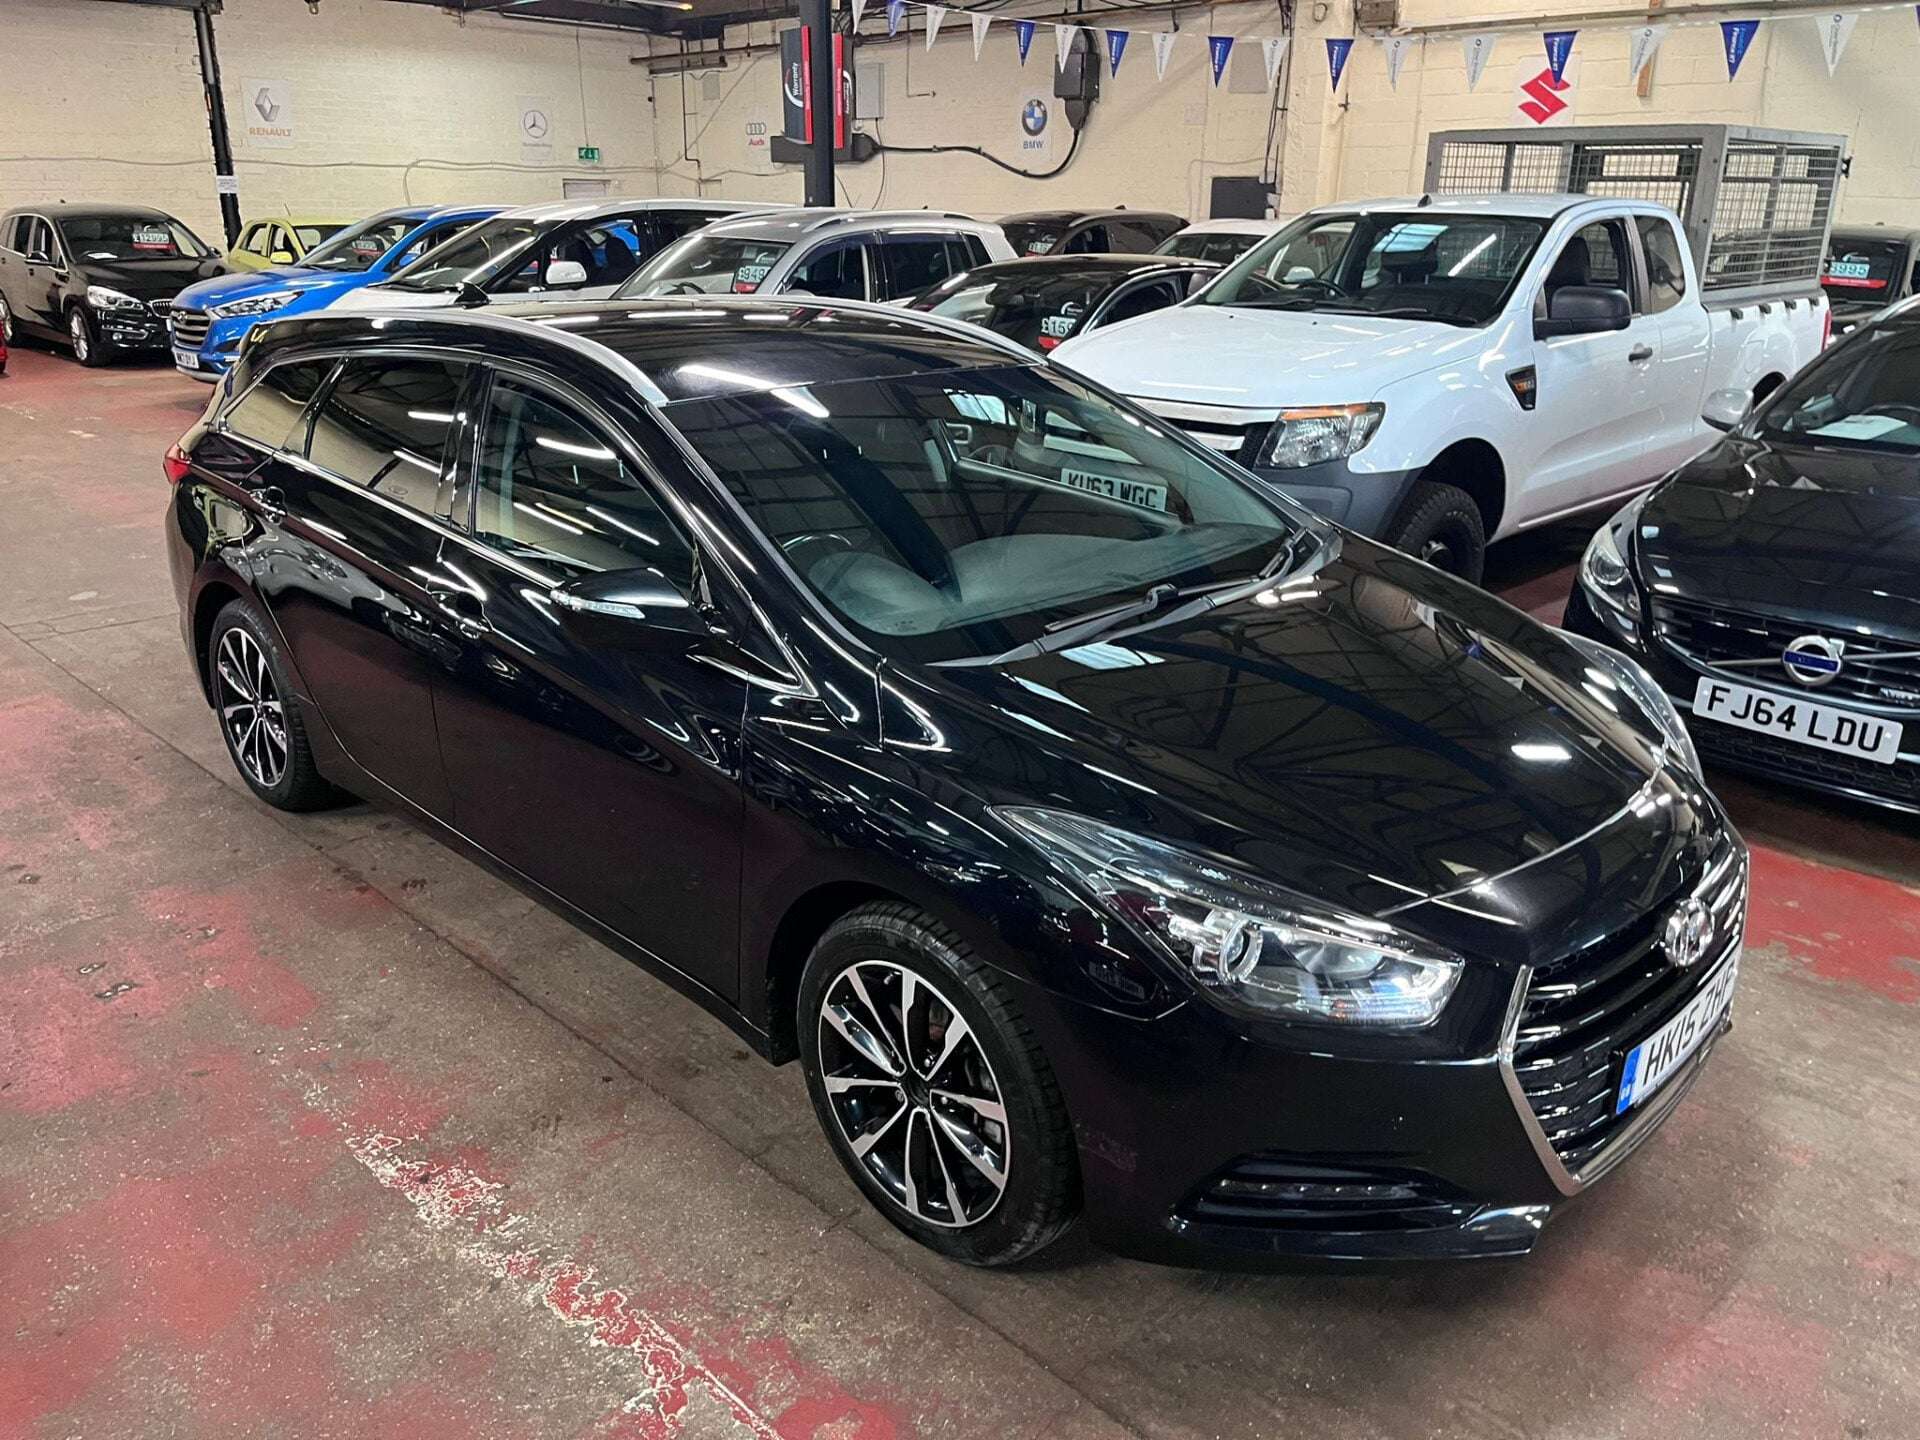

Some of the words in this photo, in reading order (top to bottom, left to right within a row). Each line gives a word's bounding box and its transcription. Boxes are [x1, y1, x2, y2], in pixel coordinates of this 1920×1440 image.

[249, 127, 292, 137] RENAULT
[748, 138, 765, 146] Audi
[1023, 140, 1044, 150] BMW
[1120, 482, 1157, 508] WGC
[1707, 685, 1797, 732] FJ64
[1807, 710, 1884, 752] LDU
[1643, 1003, 1700, 1086] HK15
